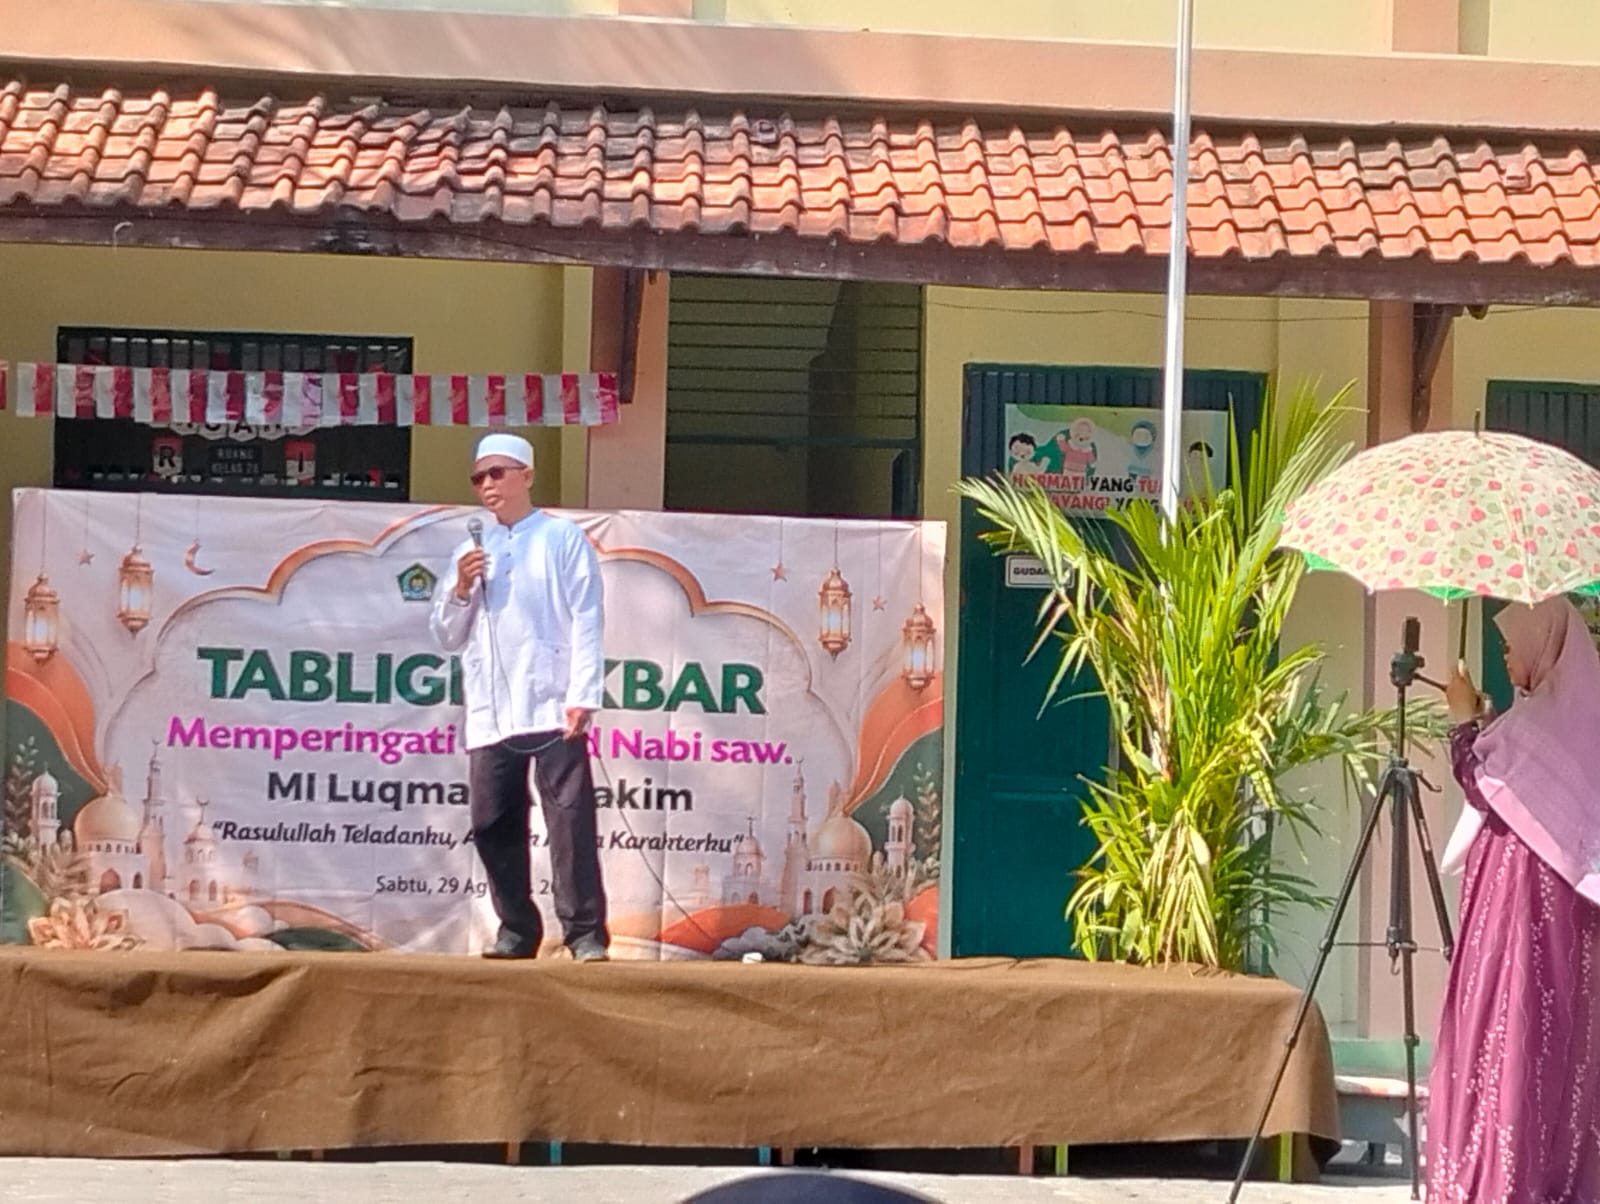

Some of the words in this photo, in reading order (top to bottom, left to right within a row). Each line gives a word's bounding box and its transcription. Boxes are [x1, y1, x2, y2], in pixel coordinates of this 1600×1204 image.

[1090, 476, 1134, 492] YANG
[1138, 478, 1162, 493] TU
[167, 716, 456, 764] Memperingati
[611, 728, 702, 762] Nabi
[710, 739, 793, 765] saw.
[268, 771, 316, 801] MI
[327, 773, 469, 812] Luqma
[595, 777, 694, 812] akim
[376, 875, 433, 895] Sabtu,
[438, 877, 460, 893] 29
